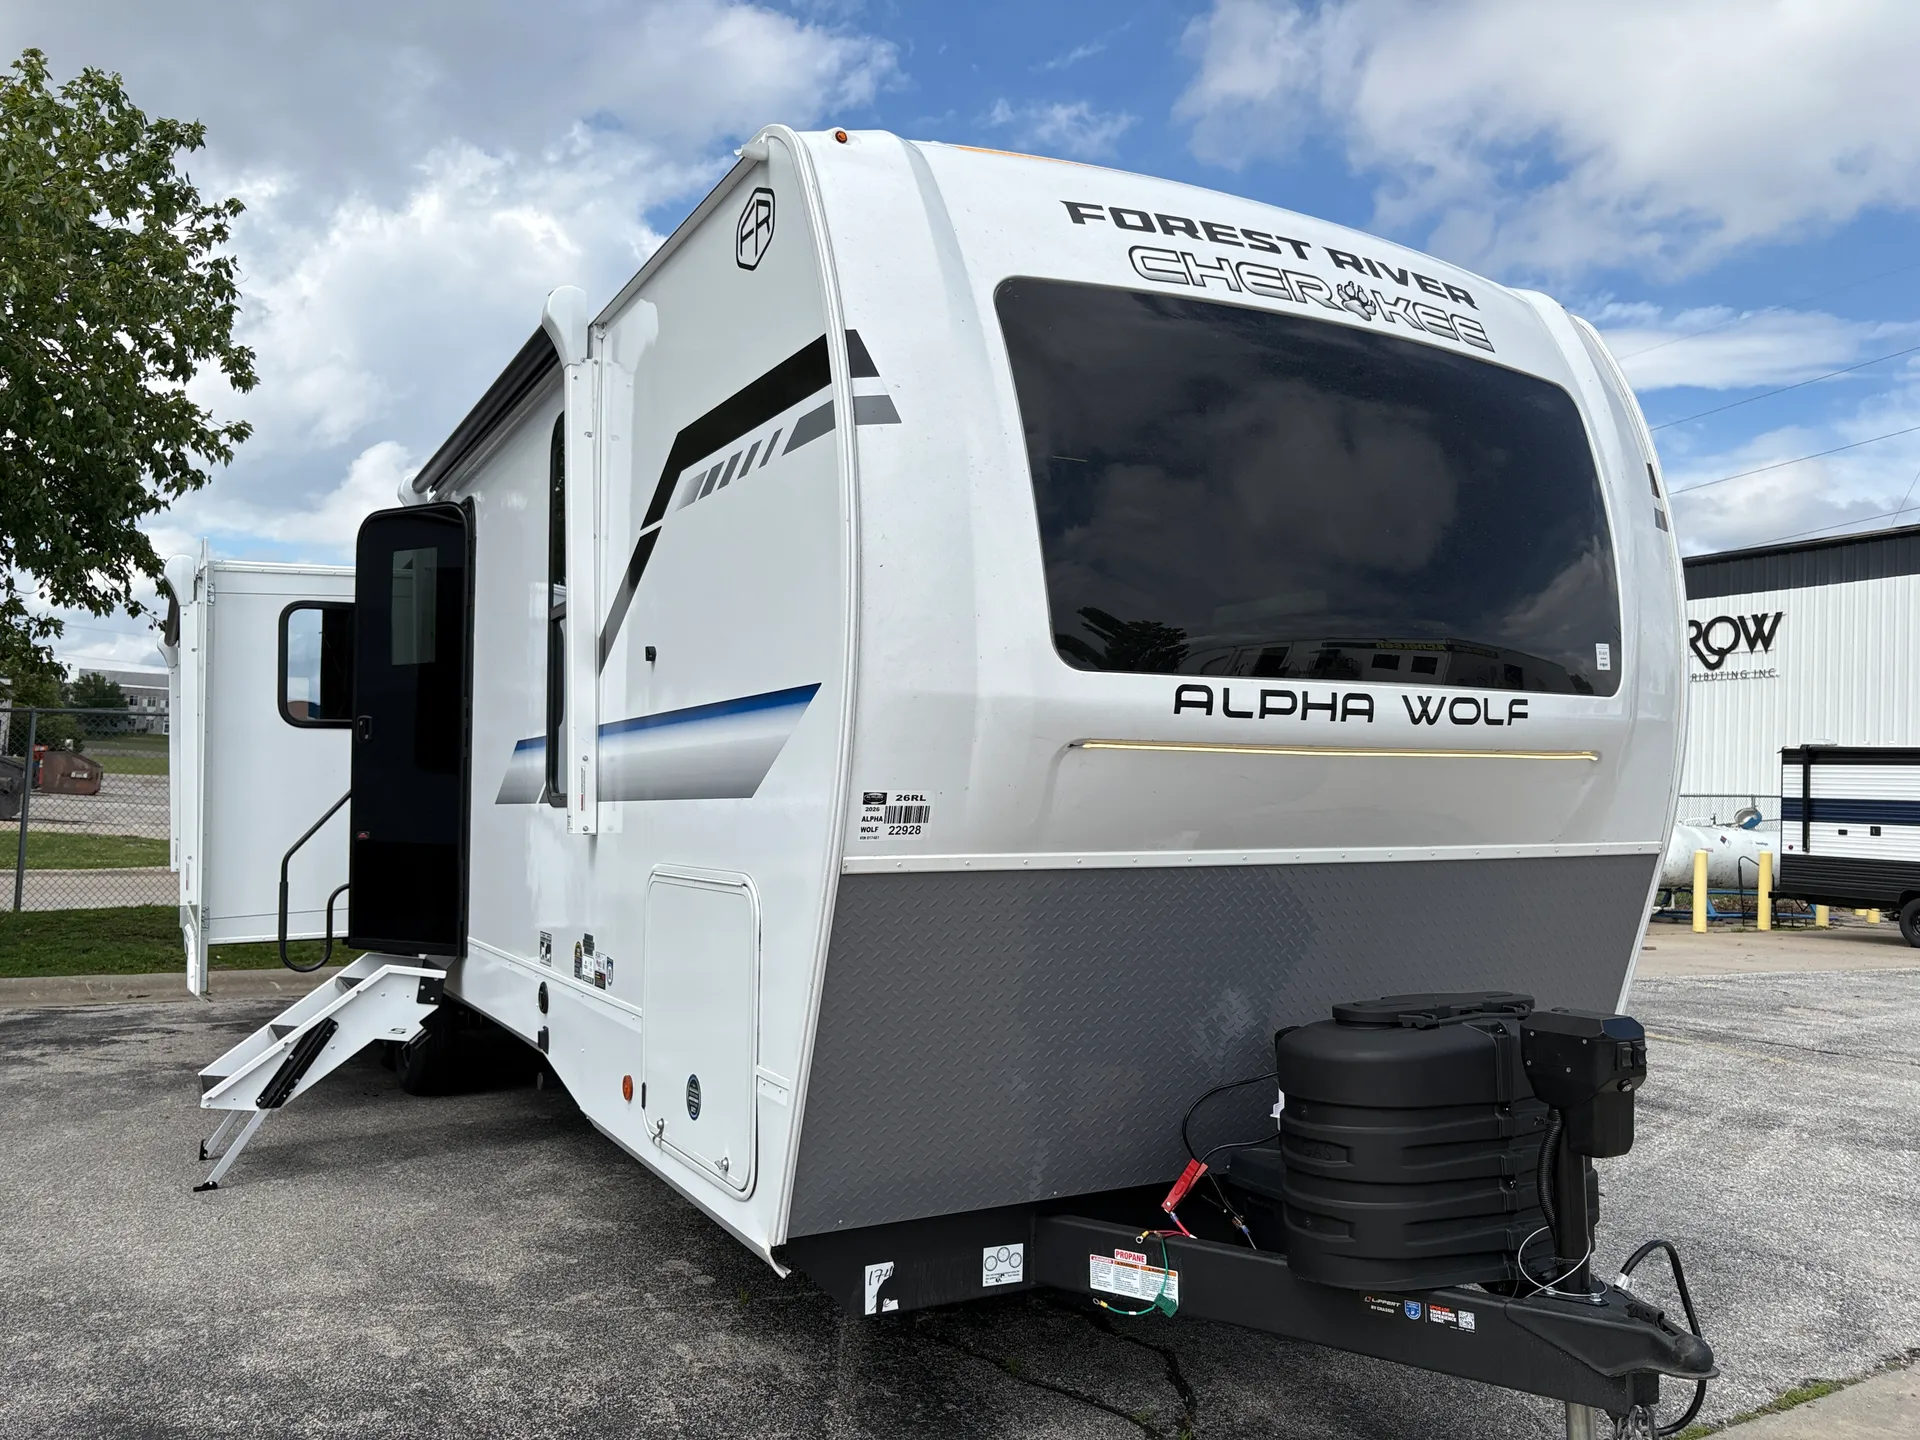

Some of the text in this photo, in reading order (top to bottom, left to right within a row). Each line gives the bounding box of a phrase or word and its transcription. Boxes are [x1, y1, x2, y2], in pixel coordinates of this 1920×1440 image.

[1059, 200, 1480, 311] FOREST RIVER
[1173, 683, 1529, 726] ALPHA WOLF
[895, 794, 927, 802] 26RL
[888, 825, 922, 836] 22928
[1115, 1250, 1145, 1263] PROPANE
